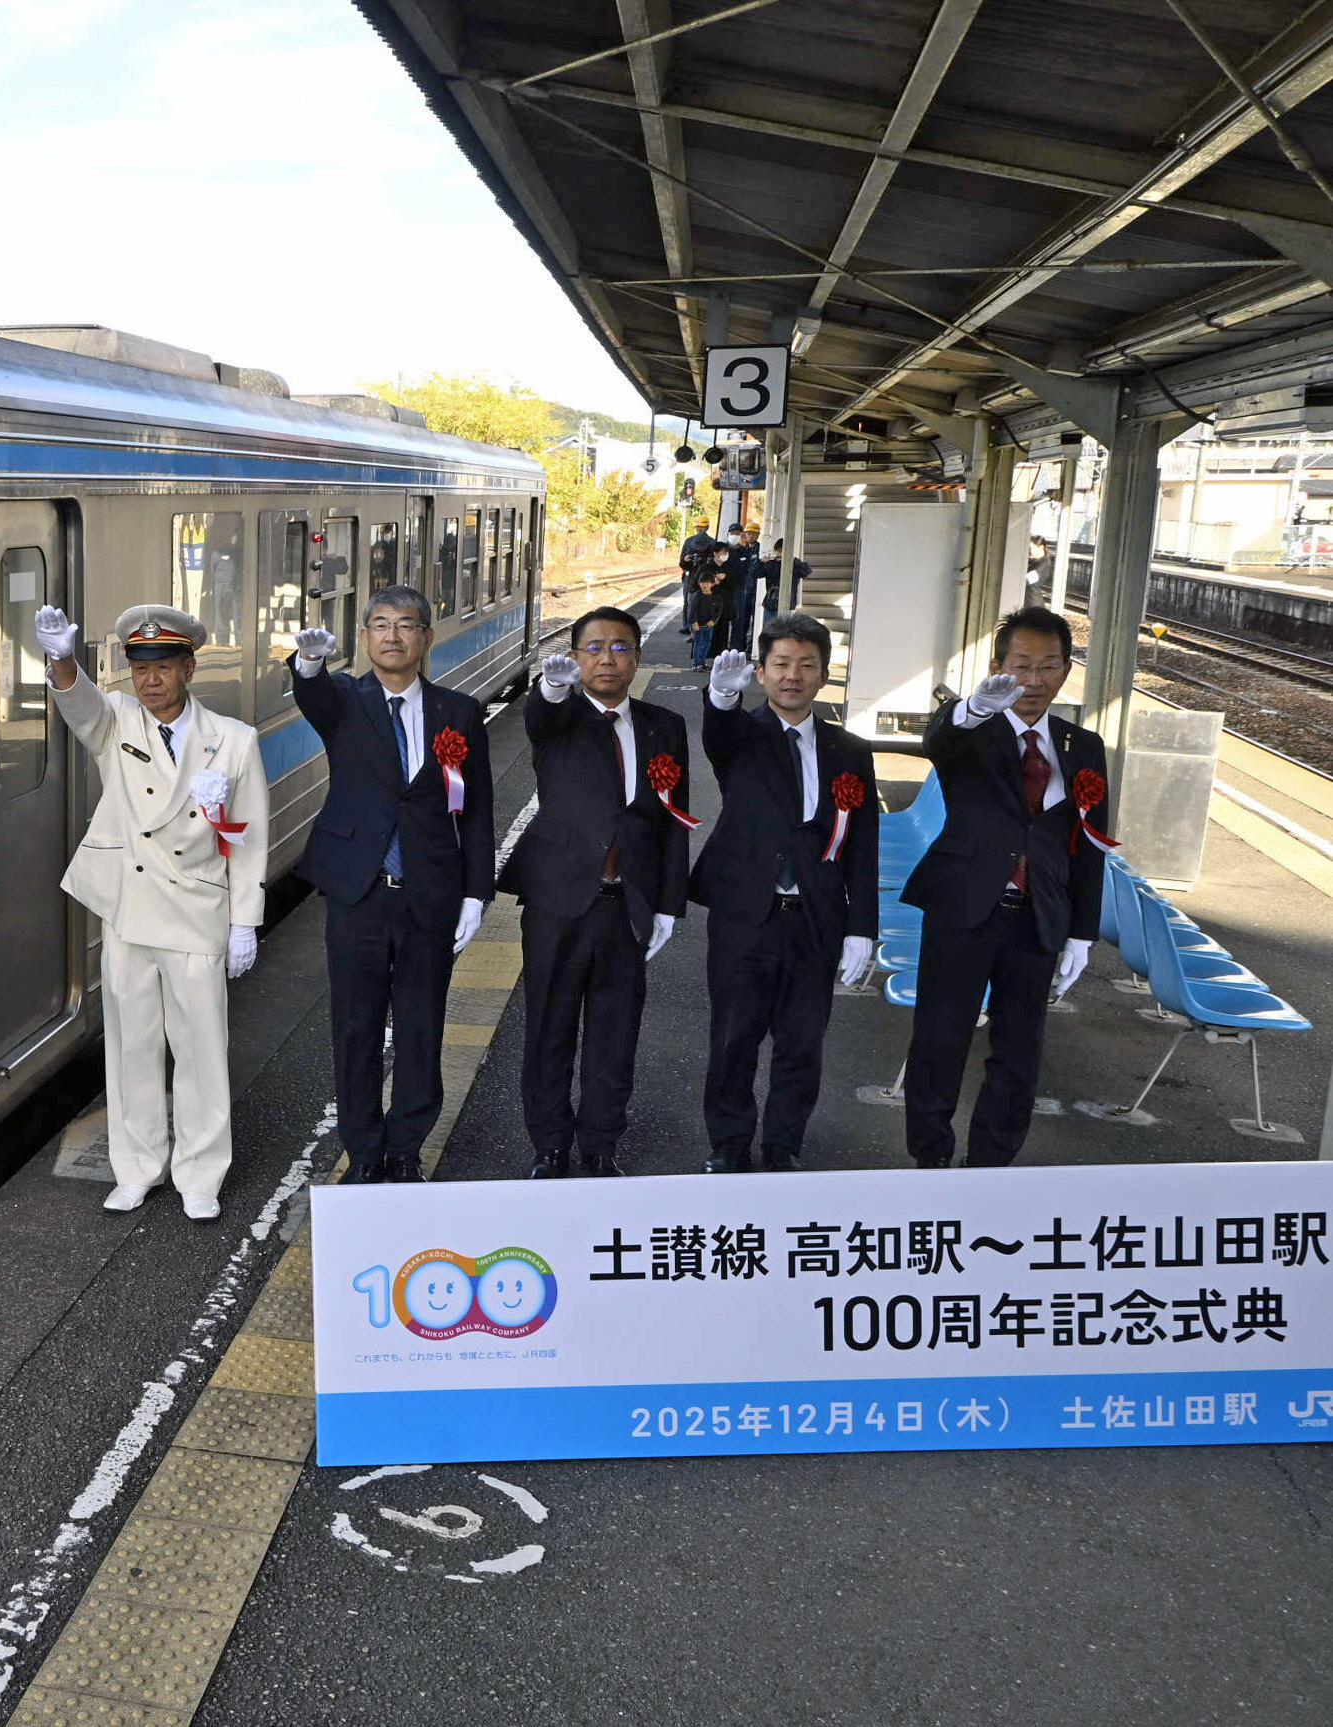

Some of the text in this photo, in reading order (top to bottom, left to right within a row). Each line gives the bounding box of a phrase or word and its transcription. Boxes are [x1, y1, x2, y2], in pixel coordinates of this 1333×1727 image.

[720, 357, 770, 417] 3
[645, 459, 656, 473] 5
[476, 1251, 548, 1274] 100TH ANNIVERSARY
[590, 1223, 769, 1281] 土讃線
[420, 1323, 530, 1339] SHIKOKU RAILWAY COMPANY
[814, 1287, 1287, 1351] 100周年記念式典
[1061, 1392, 1258, 1429] 土佐山田駅
